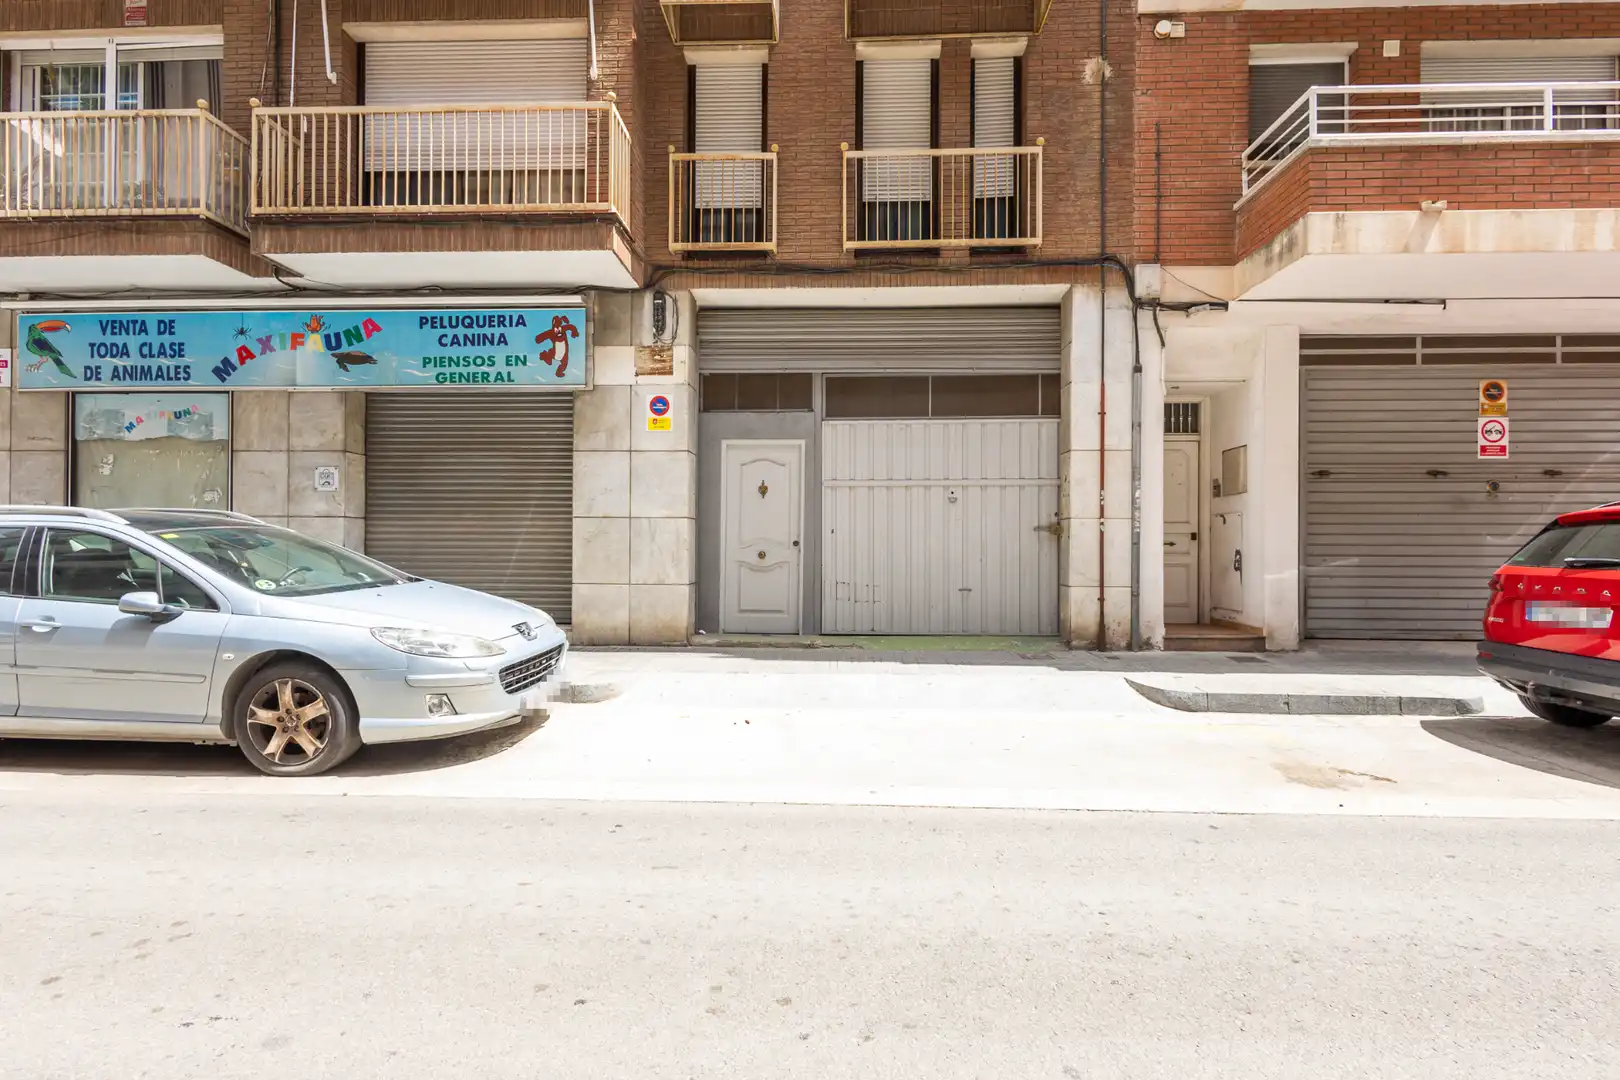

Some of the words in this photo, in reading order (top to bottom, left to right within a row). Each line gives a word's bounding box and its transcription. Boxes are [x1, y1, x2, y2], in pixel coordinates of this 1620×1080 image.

[99, 319, 149, 336] VENTA
[157, 319, 176, 336] DE
[419, 314, 527, 329] PELUQUERIA
[437, 333, 508, 348] CANINA
[88, 342, 131, 359] TODA
[138, 342, 186, 359] CLASE
[211, 317, 384, 384] MAXIFAUNA
[422, 355, 496, 369] PIENSOS
[505, 354, 528, 367] EN
[83, 365, 103, 382] DE
[110, 364, 192, 382] ANIMALES
[435, 371, 515, 384] GENERAL
